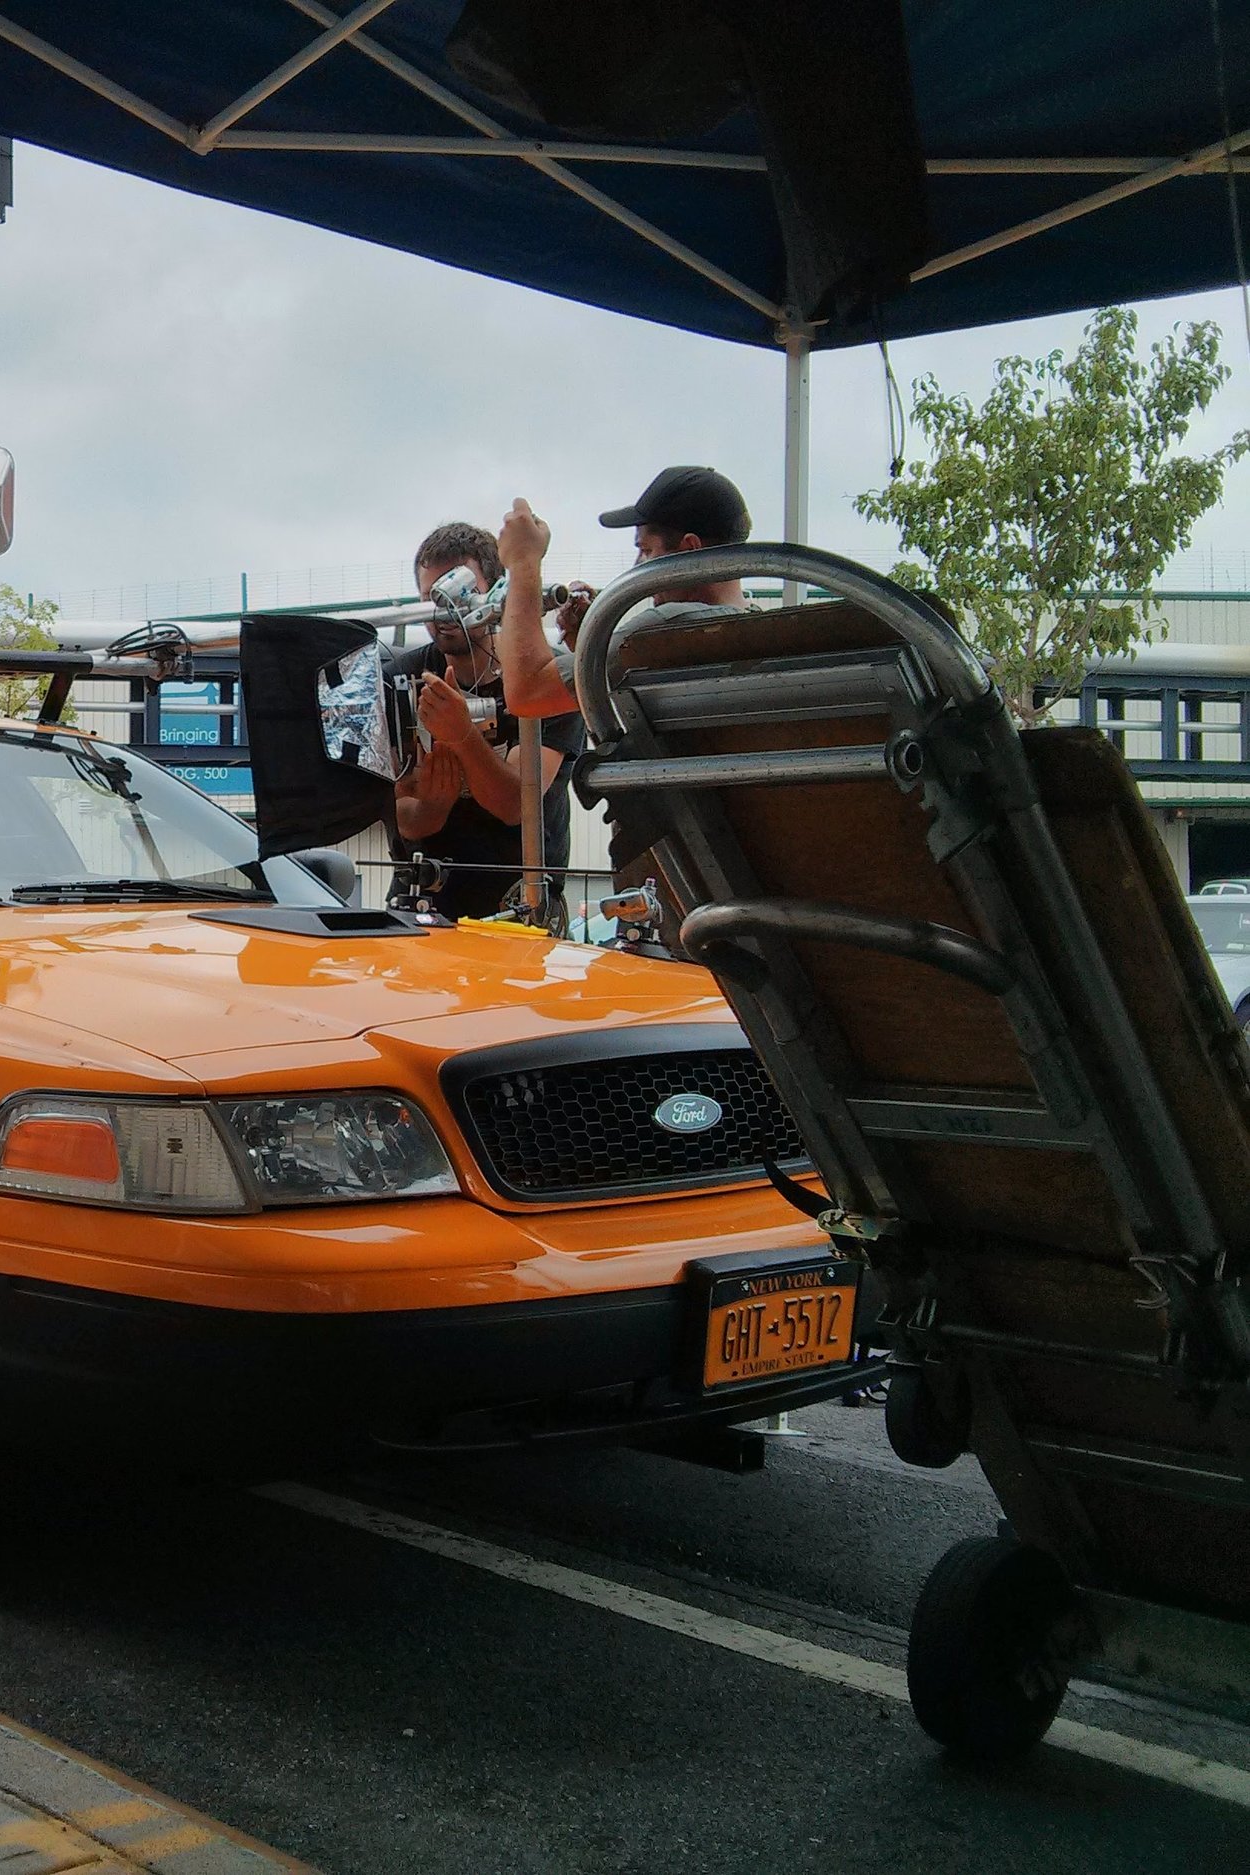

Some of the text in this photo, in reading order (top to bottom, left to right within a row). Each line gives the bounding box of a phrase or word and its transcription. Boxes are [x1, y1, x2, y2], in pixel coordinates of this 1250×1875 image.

[159, 727, 219, 744] Bringing
[167, 767, 229, 780] DG. 500
[671, 1101, 707, 1124] Ford
[748, 1271, 823, 1296] NEW YORK
[741, 1352, 816, 1376] EMPIRE STATE
